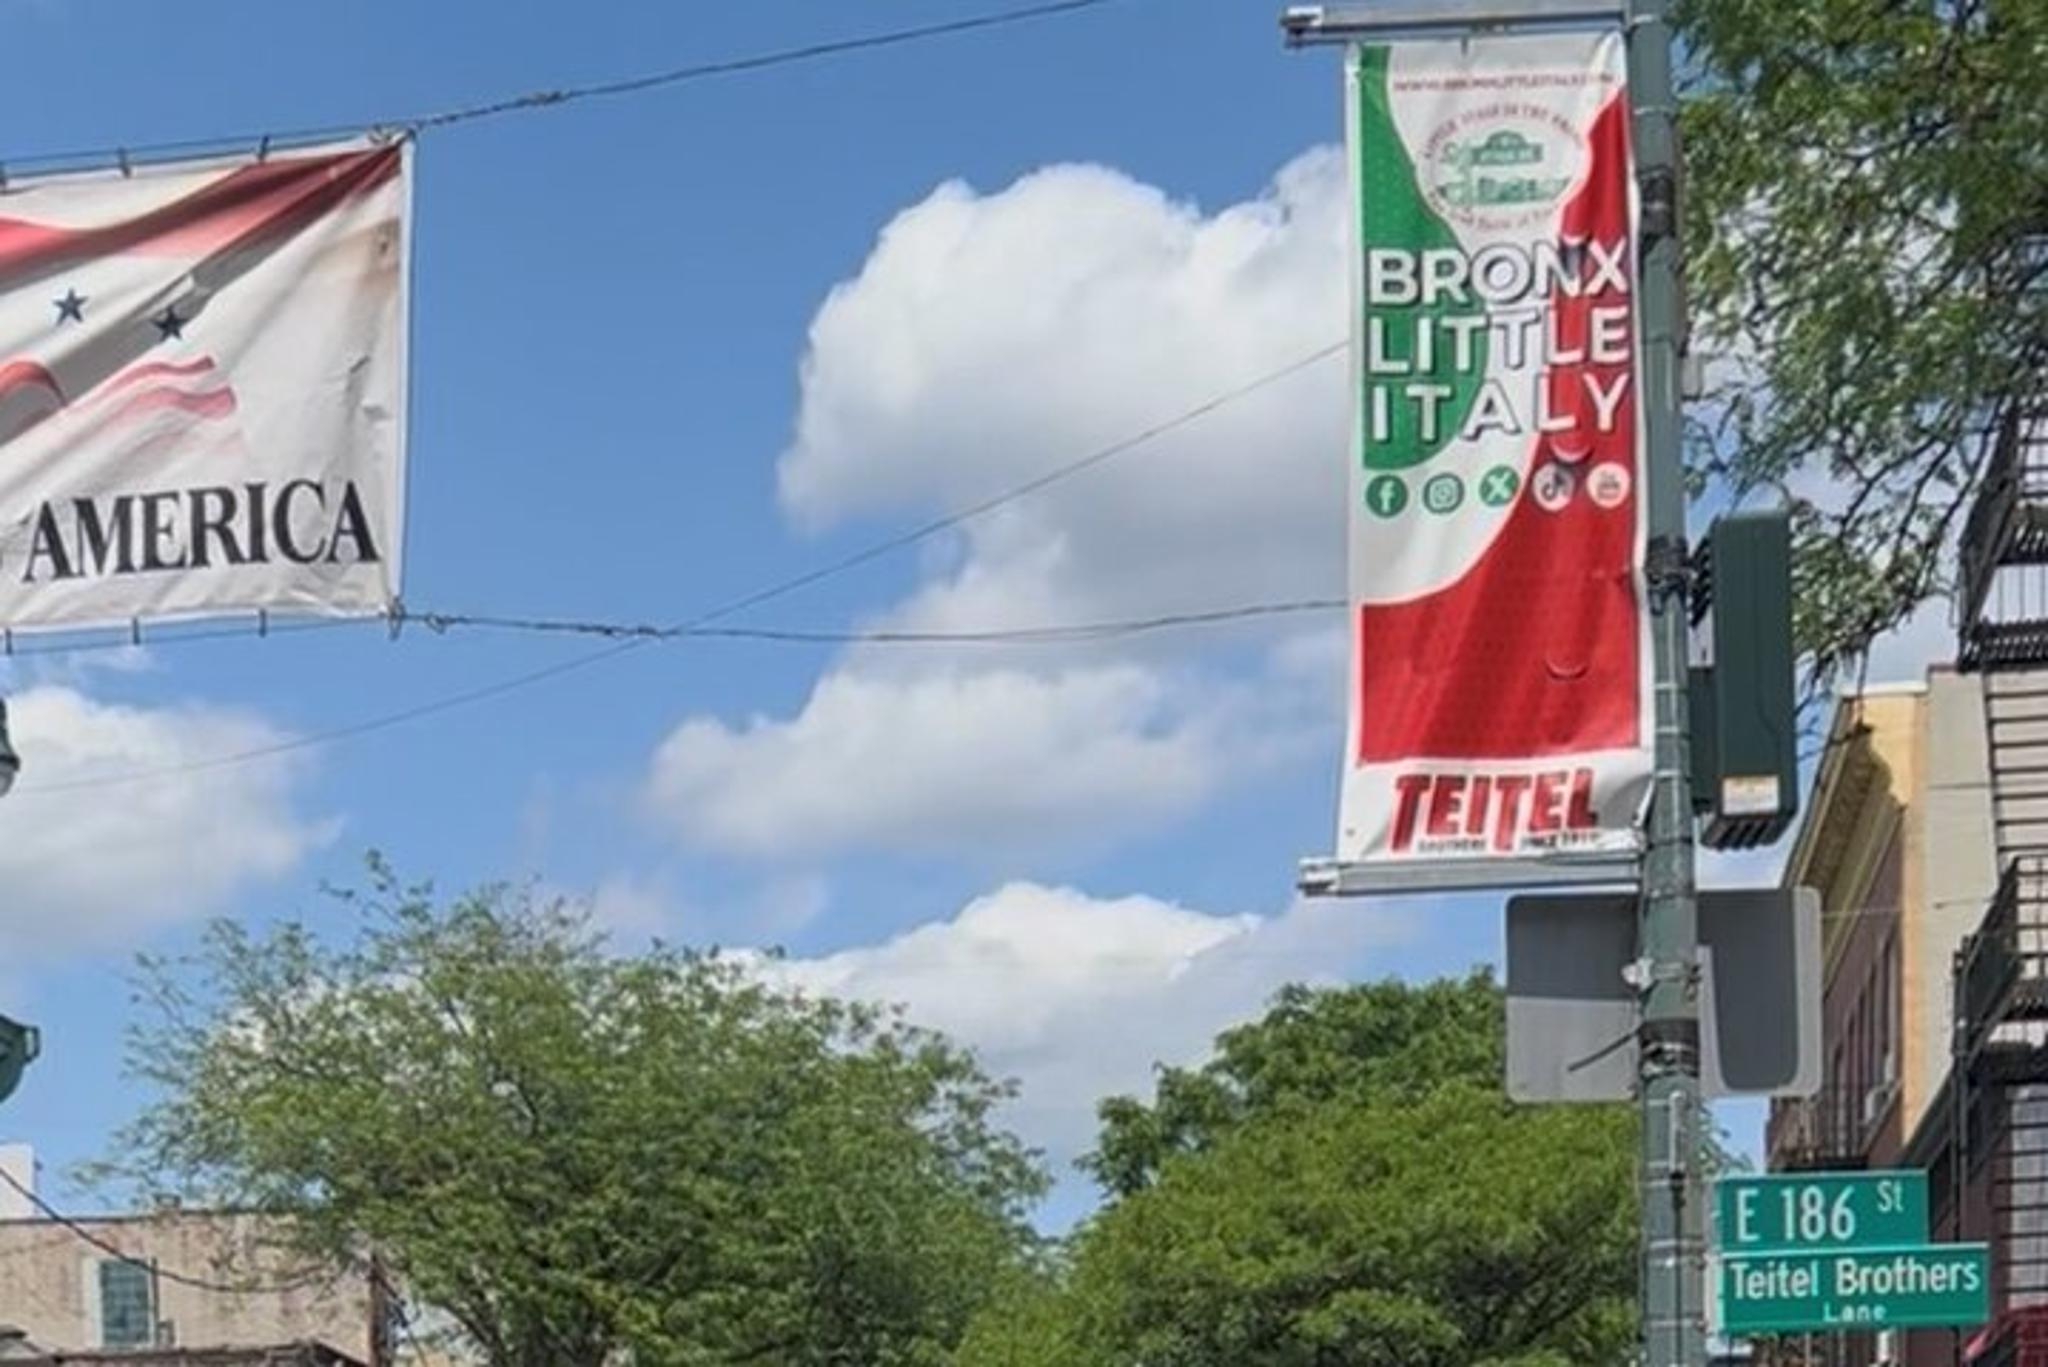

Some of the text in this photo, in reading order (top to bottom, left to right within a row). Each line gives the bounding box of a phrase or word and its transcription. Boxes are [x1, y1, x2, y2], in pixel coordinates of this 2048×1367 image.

[1368, 239, 1629, 304] BRONX
[1368, 306, 1630, 374] LITTLE
[1371, 372, 1629, 440] ITALY
[22, 478, 381, 583] AMERICA
[1390, 767, 1598, 853] TEITEL
[1736, 1179, 1904, 1242] E 186 St
[1729, 1255, 1981, 1300] Teitel Brothers
[1823, 1302, 1887, 1322] Lane
